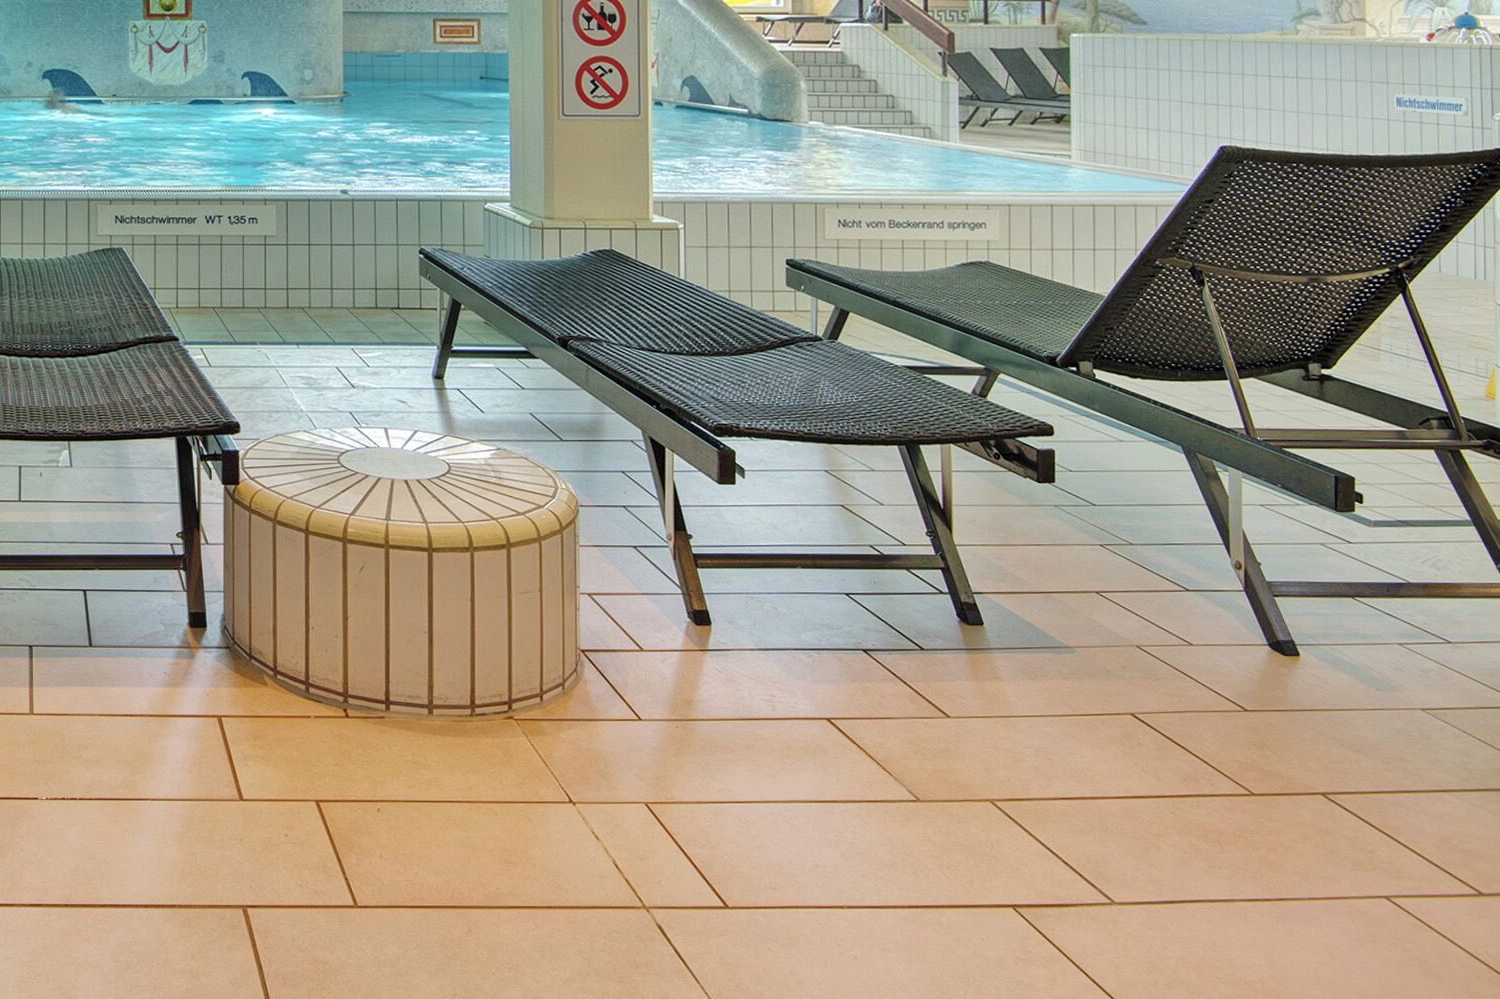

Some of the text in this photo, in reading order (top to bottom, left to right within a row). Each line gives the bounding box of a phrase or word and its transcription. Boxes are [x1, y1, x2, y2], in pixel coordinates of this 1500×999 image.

[1396, 97, 1463, 112] Nichtschwimmer
[114, 215, 258, 226] Nichtschwimmer WT 1,35 m
[837, 219, 987, 232] Nicht vom Beckenrand springen
